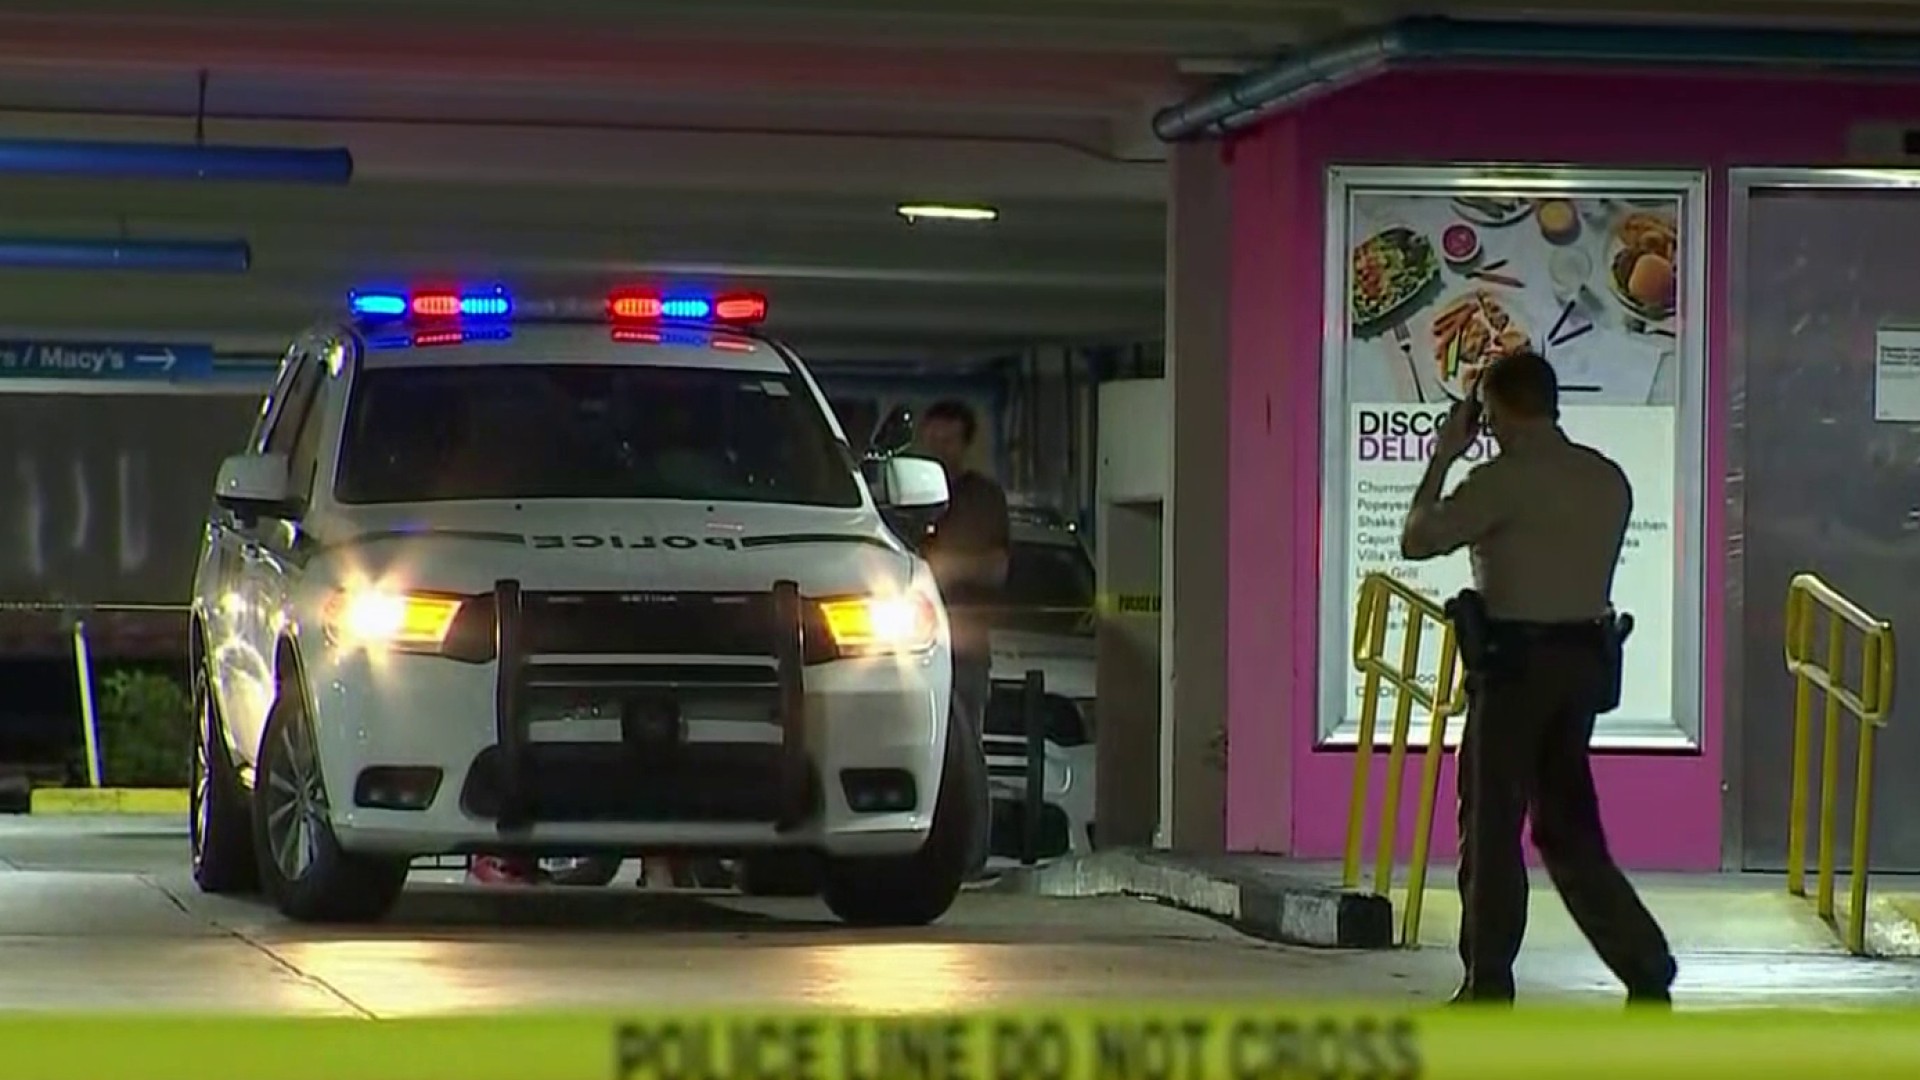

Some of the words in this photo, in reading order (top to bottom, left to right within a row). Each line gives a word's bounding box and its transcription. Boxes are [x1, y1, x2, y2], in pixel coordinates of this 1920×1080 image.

[40, 347, 125, 372] Macy's
[615, 1020, 819, 1080] POLICE
[848, 1020, 968, 1080] LINE
[993, 1020, 1069, 1080] DO
[1097, 1020, 1211, 1080] NOT
[1230, 1020, 1424, 1080] CROSS
